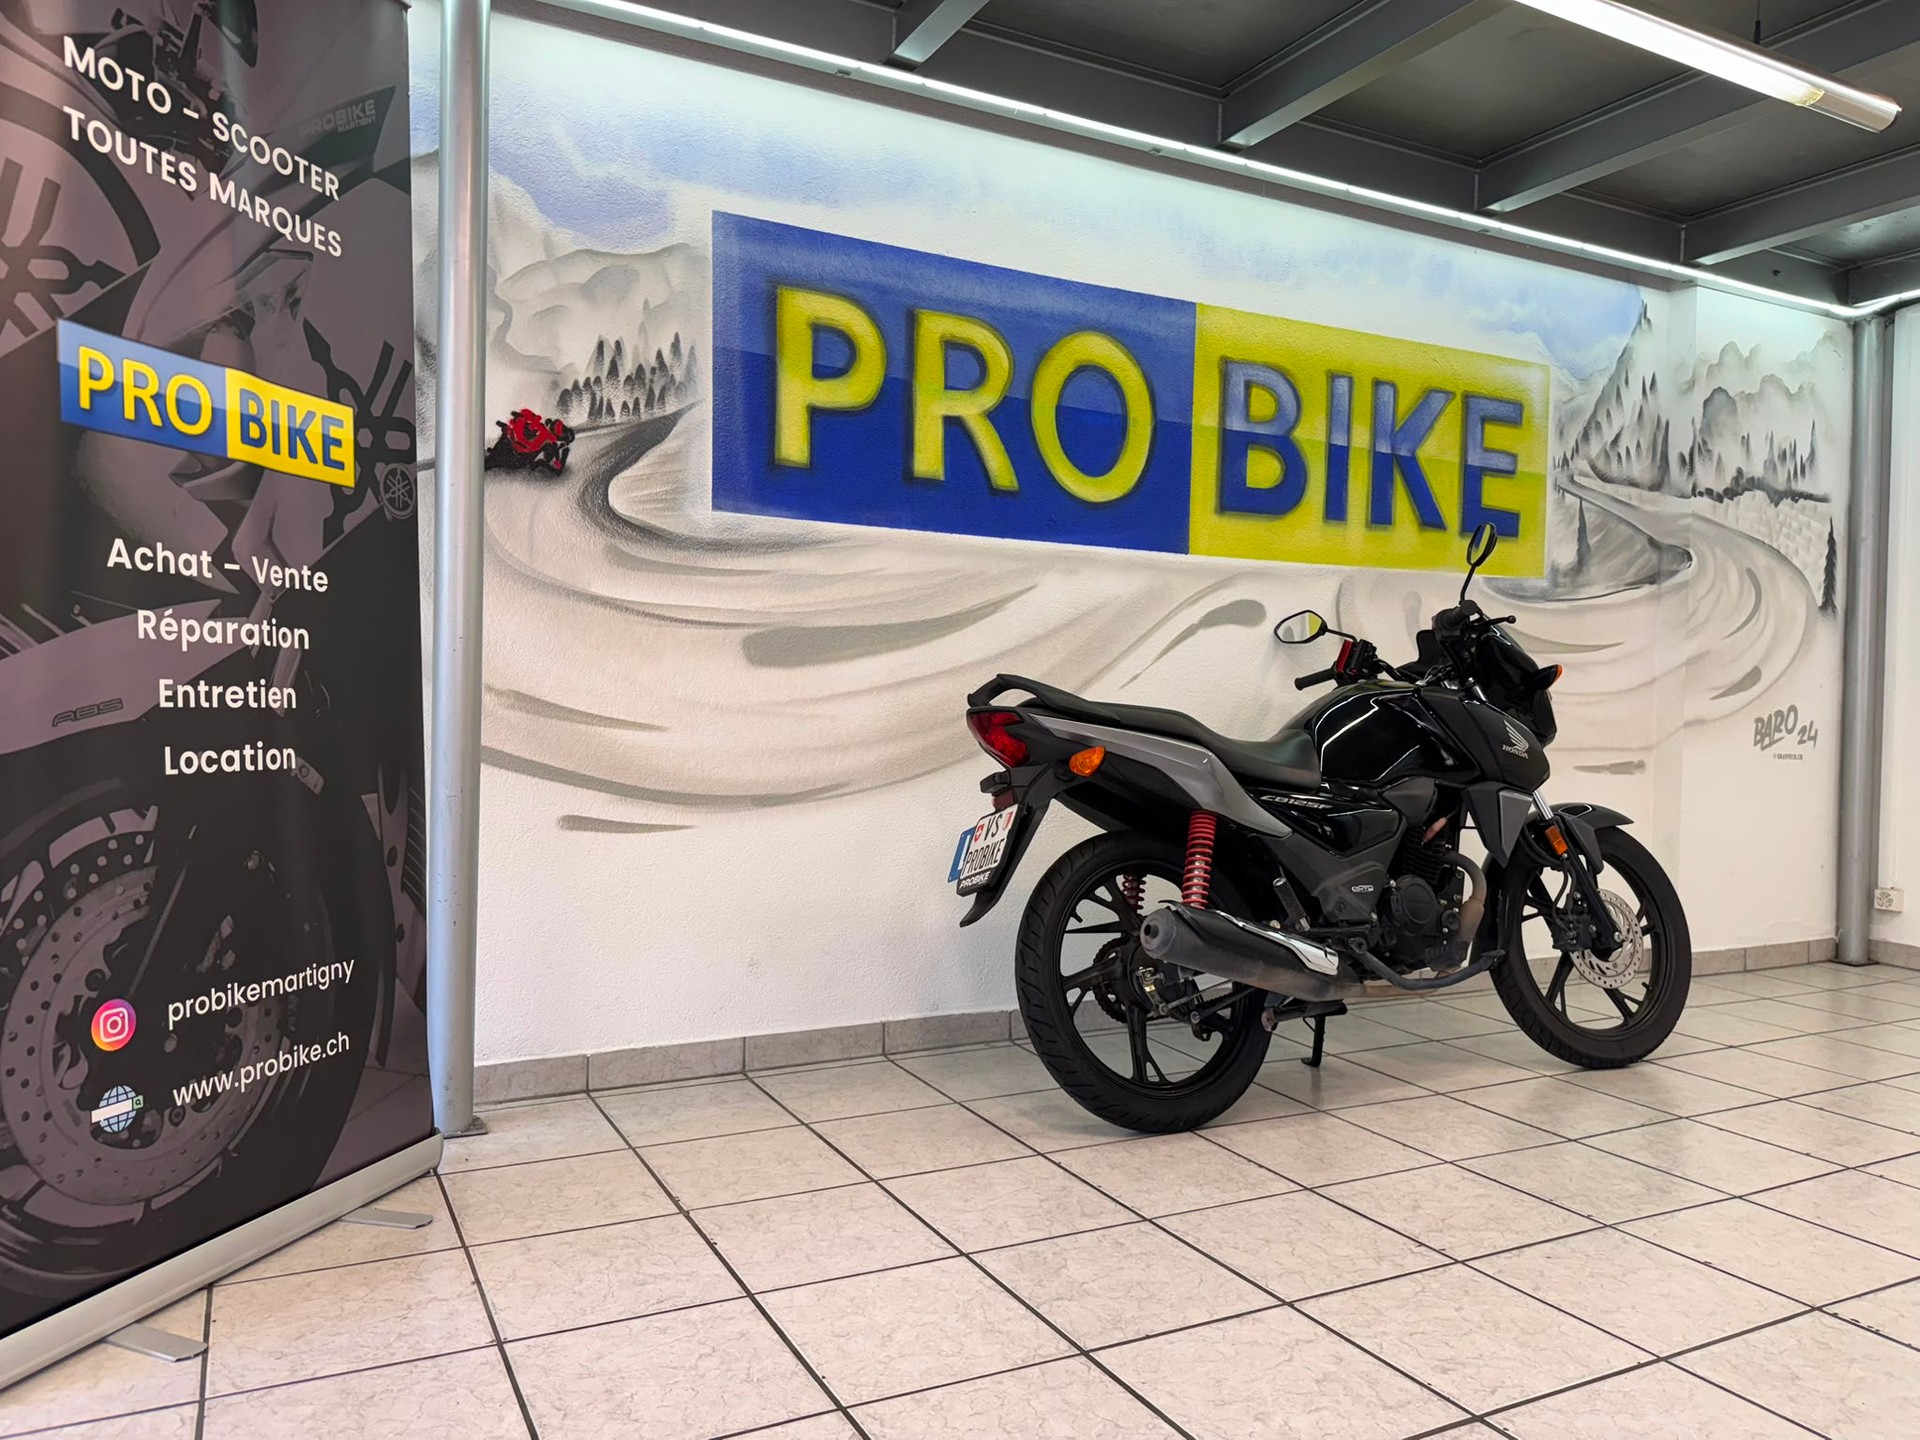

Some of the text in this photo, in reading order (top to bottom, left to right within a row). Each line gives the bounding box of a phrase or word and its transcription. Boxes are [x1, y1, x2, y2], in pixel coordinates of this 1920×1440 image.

[63, 36, 172, 115] MOTO
[212, 112, 340, 201] SCOOTER
[63, 106, 342, 257] TOUTES MARQUES
[78, 346, 346, 471] PRO BIKE
[775, 286, 1526, 539] PRO BIKE
[107, 538, 212, 579] Achat
[252, 556, 329, 592] Vente
[137, 609, 310, 650] Réparation
[52, 698, 124, 727] ABS
[159, 678, 297, 710] Entretien
[1753, 704, 1818, 750] BARO 24
[164, 741, 297, 775] Location
[1501, 744, 1529, 759] HONDA
[983, 813, 1003, 842] VS
[961, 838, 1006, 877] PROBIKE
[959, 871, 991, 889] PROBIKE
[168, 958, 355, 1029] probikemartigny
[172, 1031, 351, 1107] www.probike.ch
